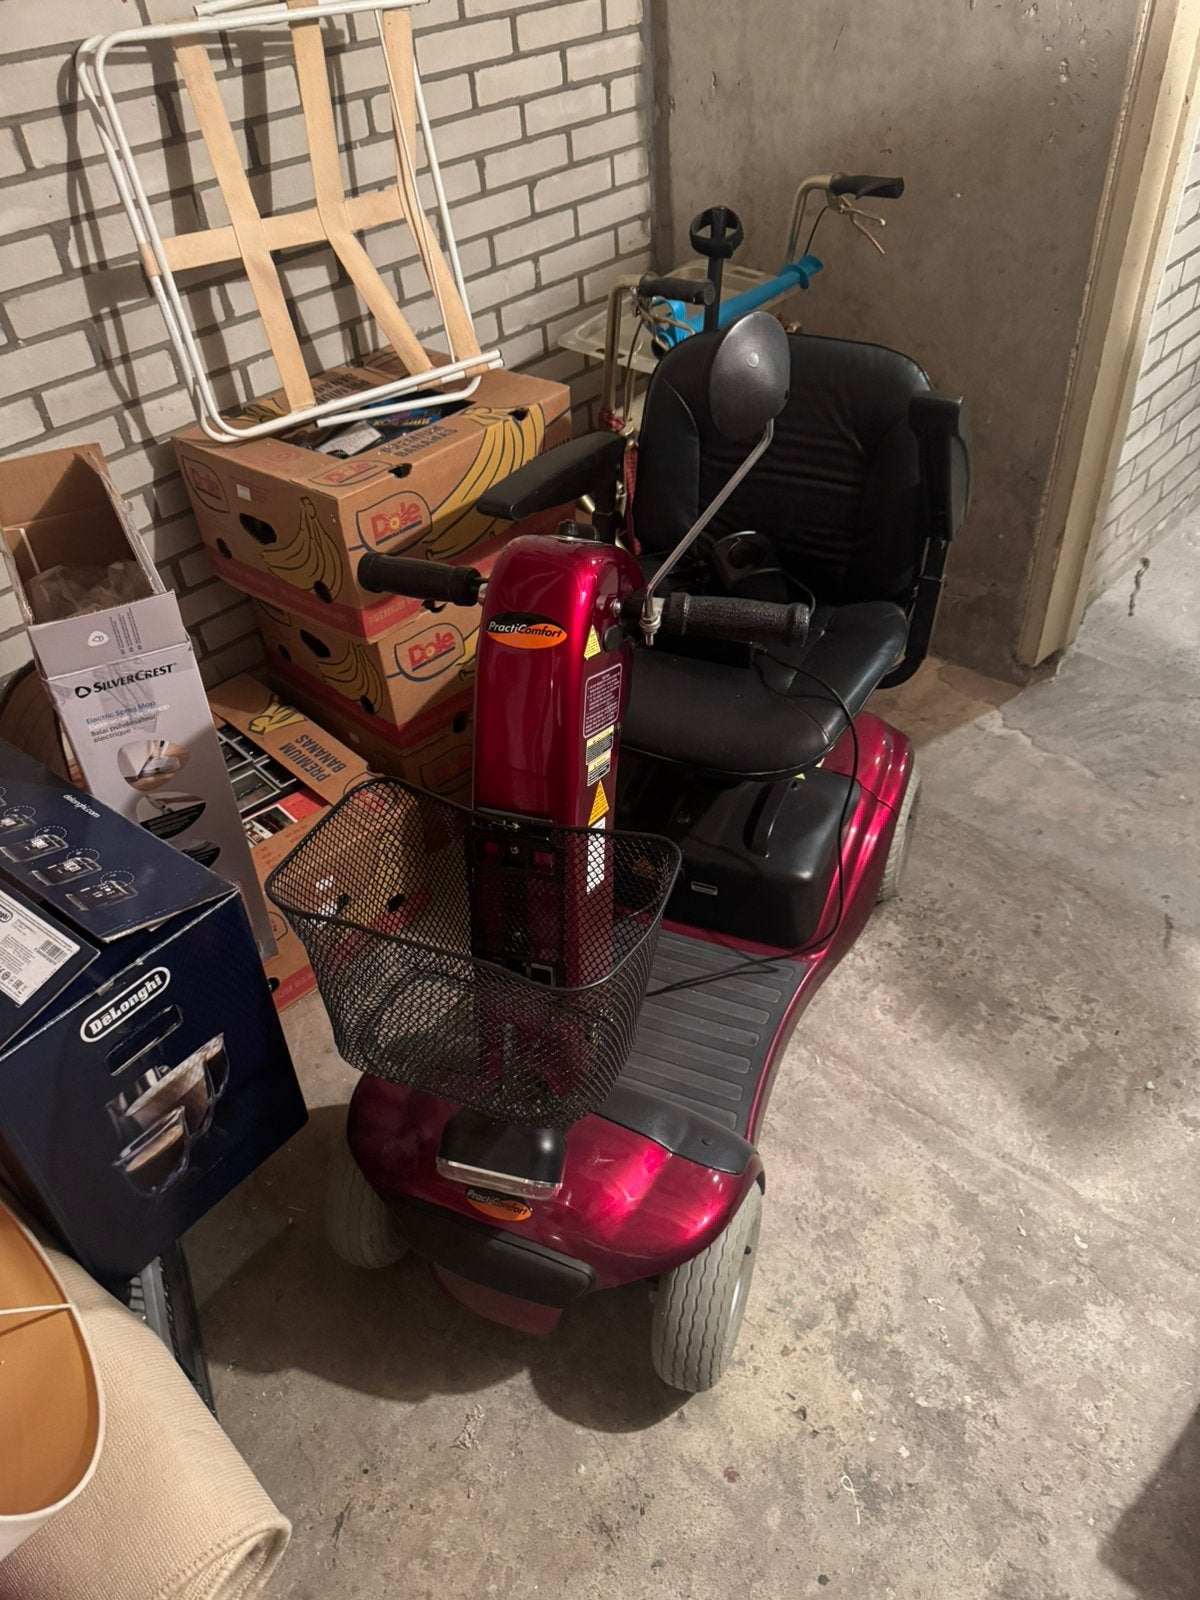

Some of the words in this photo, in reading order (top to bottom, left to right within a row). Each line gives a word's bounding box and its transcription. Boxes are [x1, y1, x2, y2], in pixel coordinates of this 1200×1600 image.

[370, 501, 422, 542] Dole
[487, 620, 564, 638] PractiComfort
[407, 632, 455, 668] Dole
[86, 710, 117, 725] Electric
[138, 700, 156, 711] Mop
[91, 728, 109, 738] Balai
[278, 742, 331, 782] PREMIUM
[295, 734, 347, 773] BANANAS
[467, 1189, 528, 1216] PractiComfort
